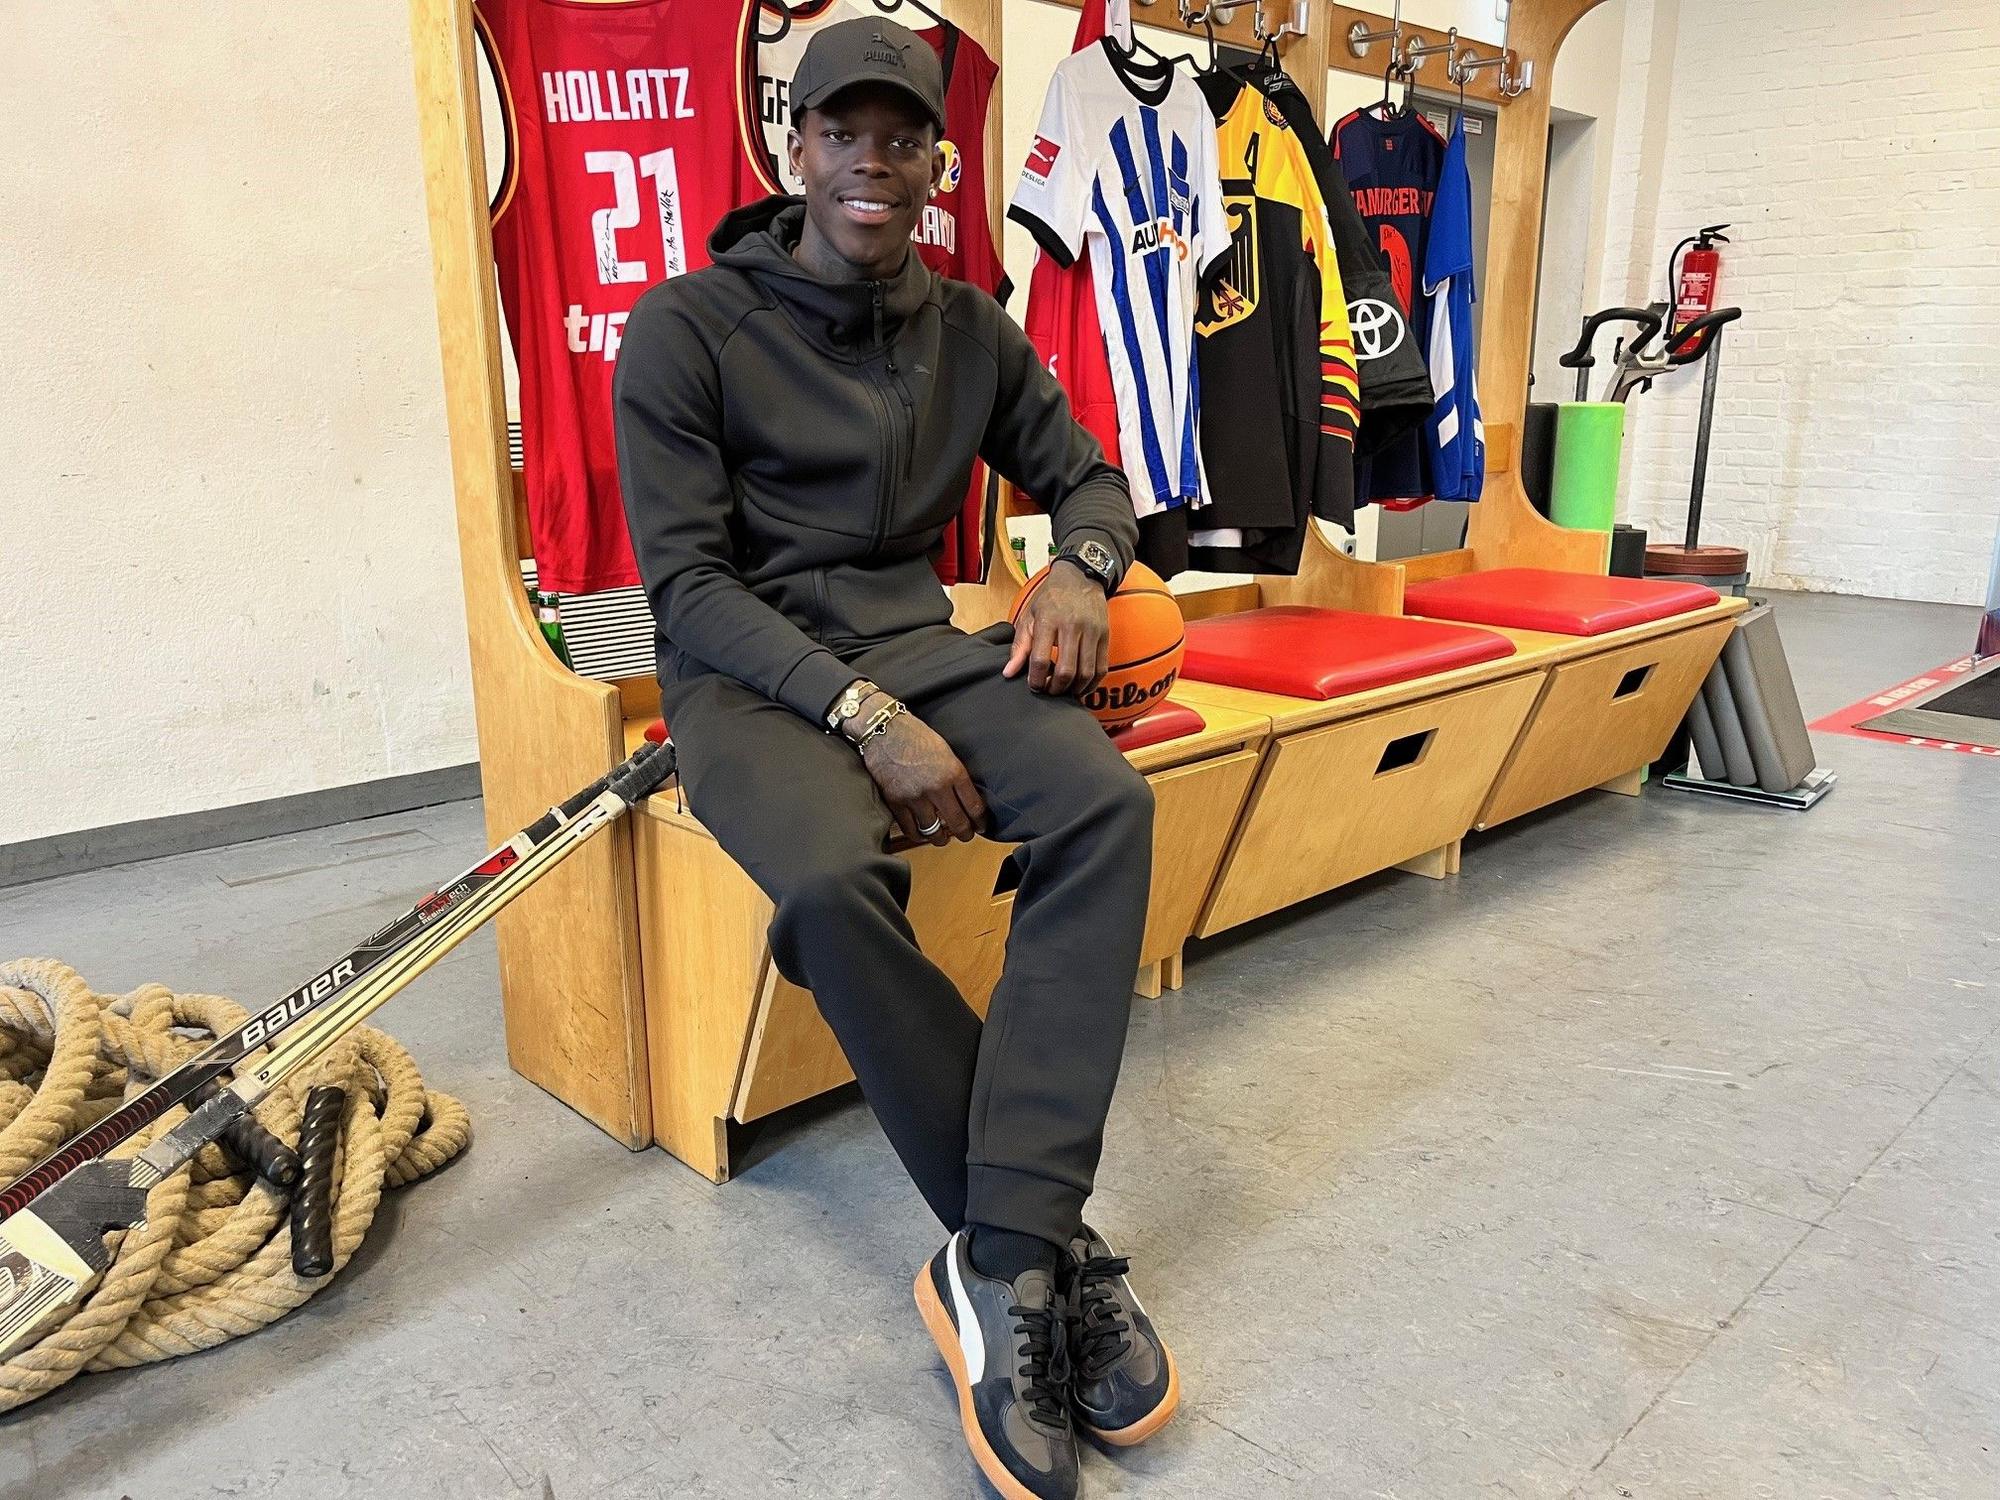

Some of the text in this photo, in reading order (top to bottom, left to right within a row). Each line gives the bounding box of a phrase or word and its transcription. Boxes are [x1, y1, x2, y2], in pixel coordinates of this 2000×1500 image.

[542, 67, 695, 123] HOLLATZ
[584, 147, 687, 285] 21
[909, 204, 956, 255] LAND
